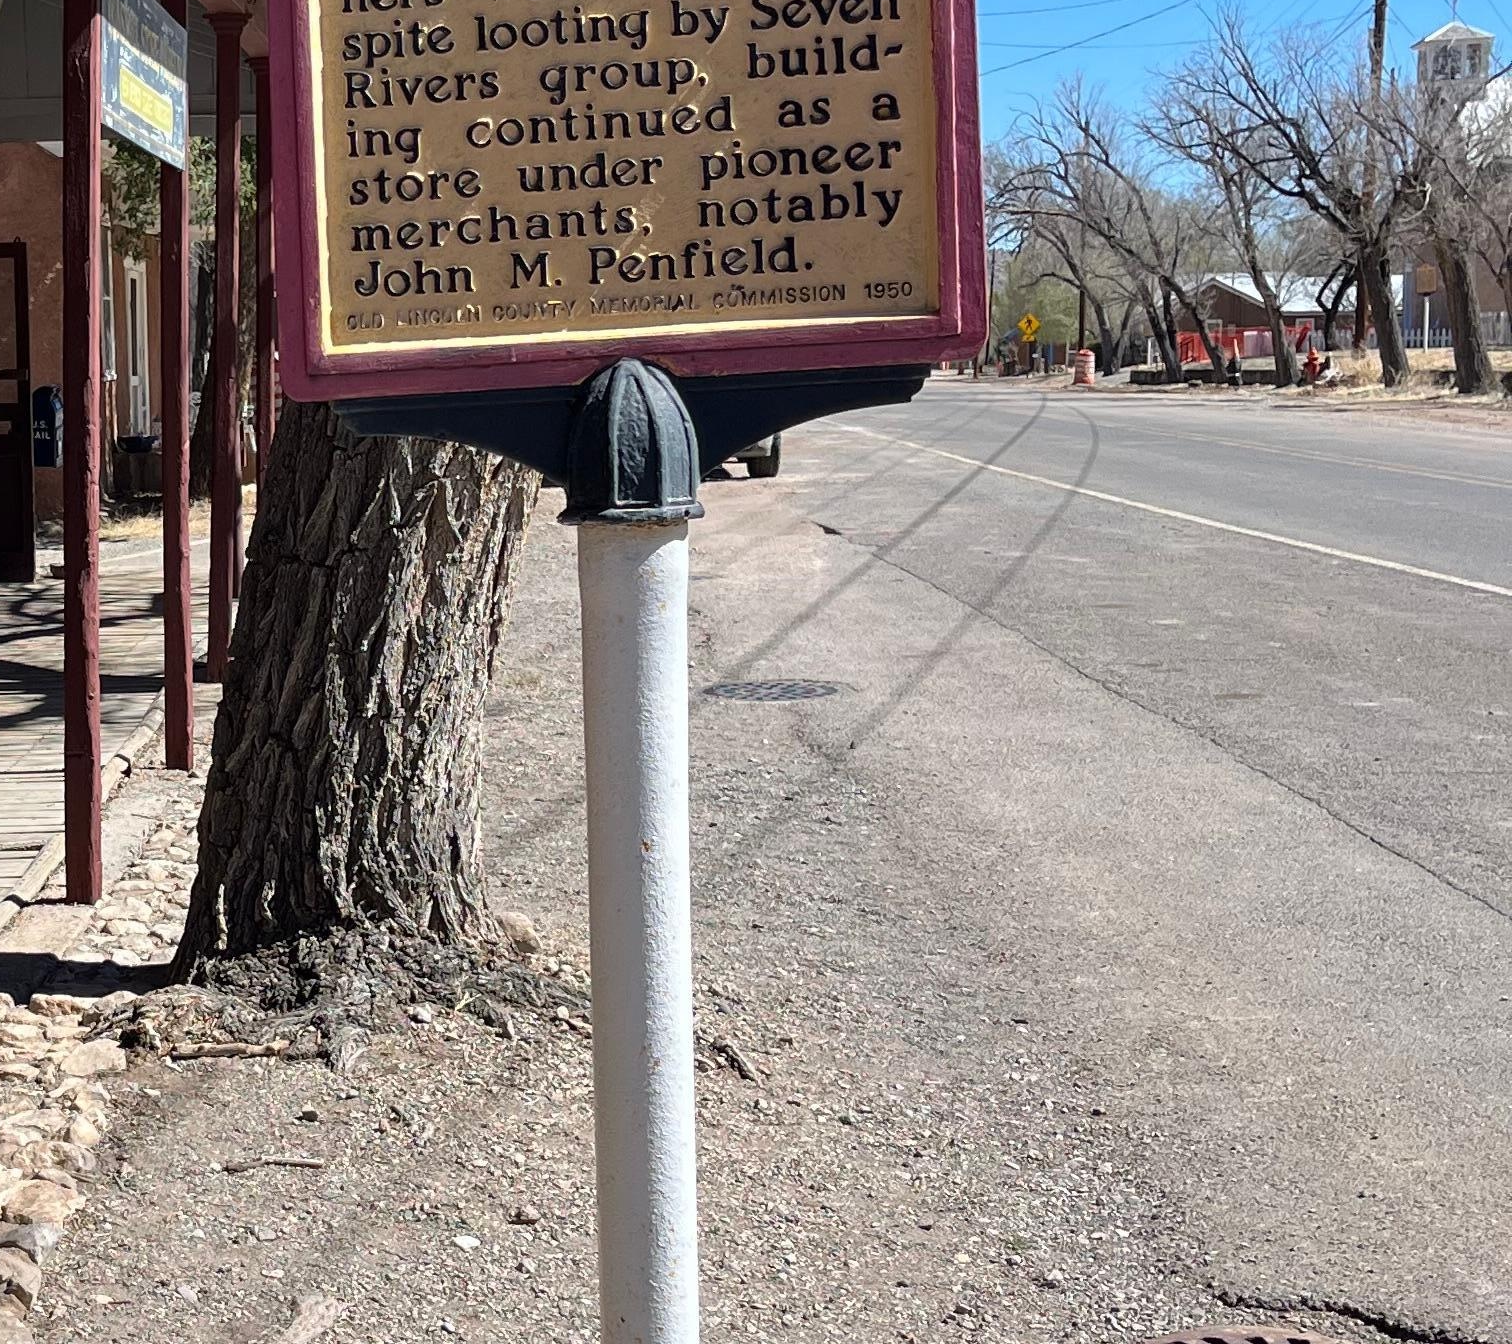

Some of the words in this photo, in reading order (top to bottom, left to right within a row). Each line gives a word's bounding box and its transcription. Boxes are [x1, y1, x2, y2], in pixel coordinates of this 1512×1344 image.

[343, 20, 454, 69] spite
[474, 6, 649, 51] looting
[671, 0, 729, 44] by
[344, 68, 499, 108] Rivers
[539, 60, 705, 105] group,
[747, 33, 902, 79] build-
[347, 120, 421, 163] ing
[466, 96, 734, 148] continued
[778, 98, 830, 128] as
[872, 93, 900, 121] a
[350, 168, 481, 205] store
[517, 153, 662, 192] under
[700, 140, 902, 192] pioneer
[351, 201, 650, 251] merchants,
[697, 181, 903, 227] notably
[355, 261, 473, 296] John
[510, 253, 561, 289] M.
[588, 236, 814, 284] Penfield.
[346, 312, 384, 331] OLD
[397, 305, 482, 327] LINCOLN
[492, 300, 577, 322] COUNTY
[590, 295, 697, 316] MEMORIAL
[863, 281, 914, 300] 1950
[33, 431, 51, 439] AIL
